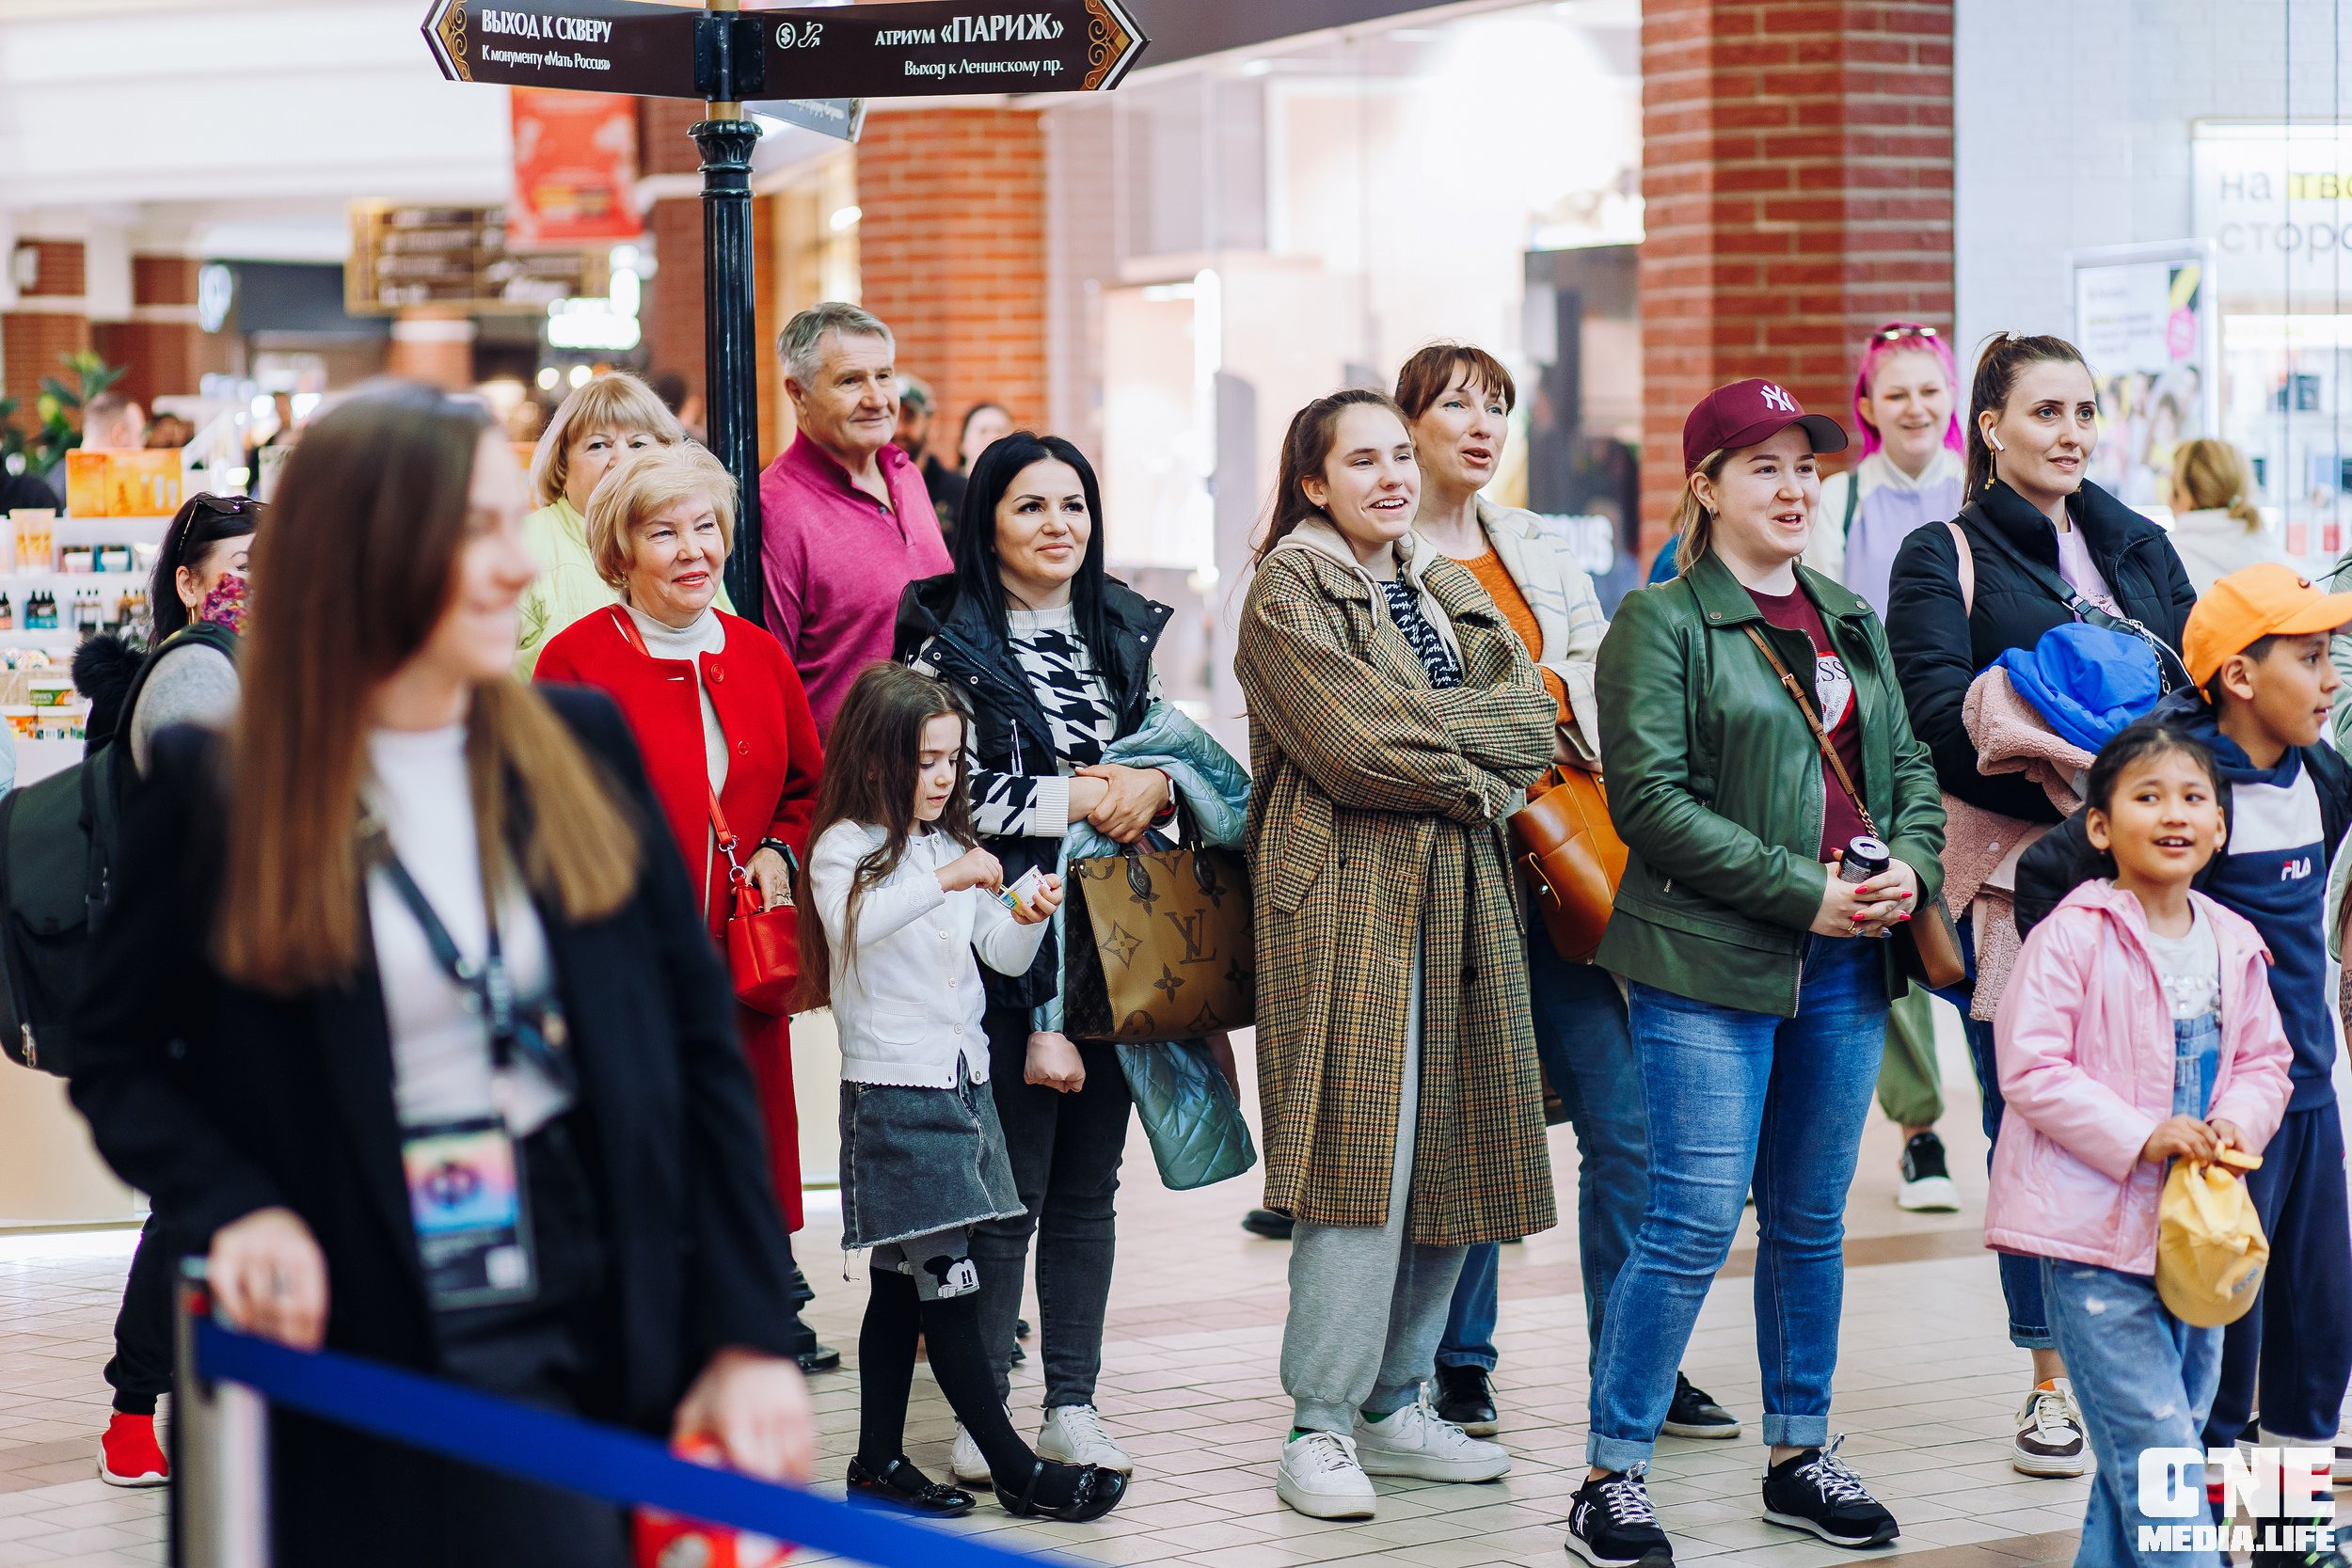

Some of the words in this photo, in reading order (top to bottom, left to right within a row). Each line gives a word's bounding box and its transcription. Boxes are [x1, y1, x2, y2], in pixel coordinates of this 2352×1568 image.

[482, 8, 541, 40] ВЫХОД
[542, 15, 554, 39] К
[555, 16, 613, 43] СКВЕРУ
[874, 28, 936, 46] АТРИУМ
[940, 12, 1065, 43] «ПАРИЖ»
[482, 44, 490, 61] К
[490, 49, 544, 71] монументу
[544, 50, 573, 69] «Мать
[574, 53, 612, 71] Россия»
[904, 60, 946, 80] Выход
[948, 63, 957, 75] к
[959, 58, 1041, 77] Ленинскому
[1042, 59, 1065, 76] пр.
[2219, 170, 2272, 201] на
[2291, 171, 2352, 200] тв
[1760, 384, 1796, 413] NY
[1816, 660, 1849, 684] SS
[2280, 856, 2312, 882] FILA
[1164, 908, 1217, 965] LV
